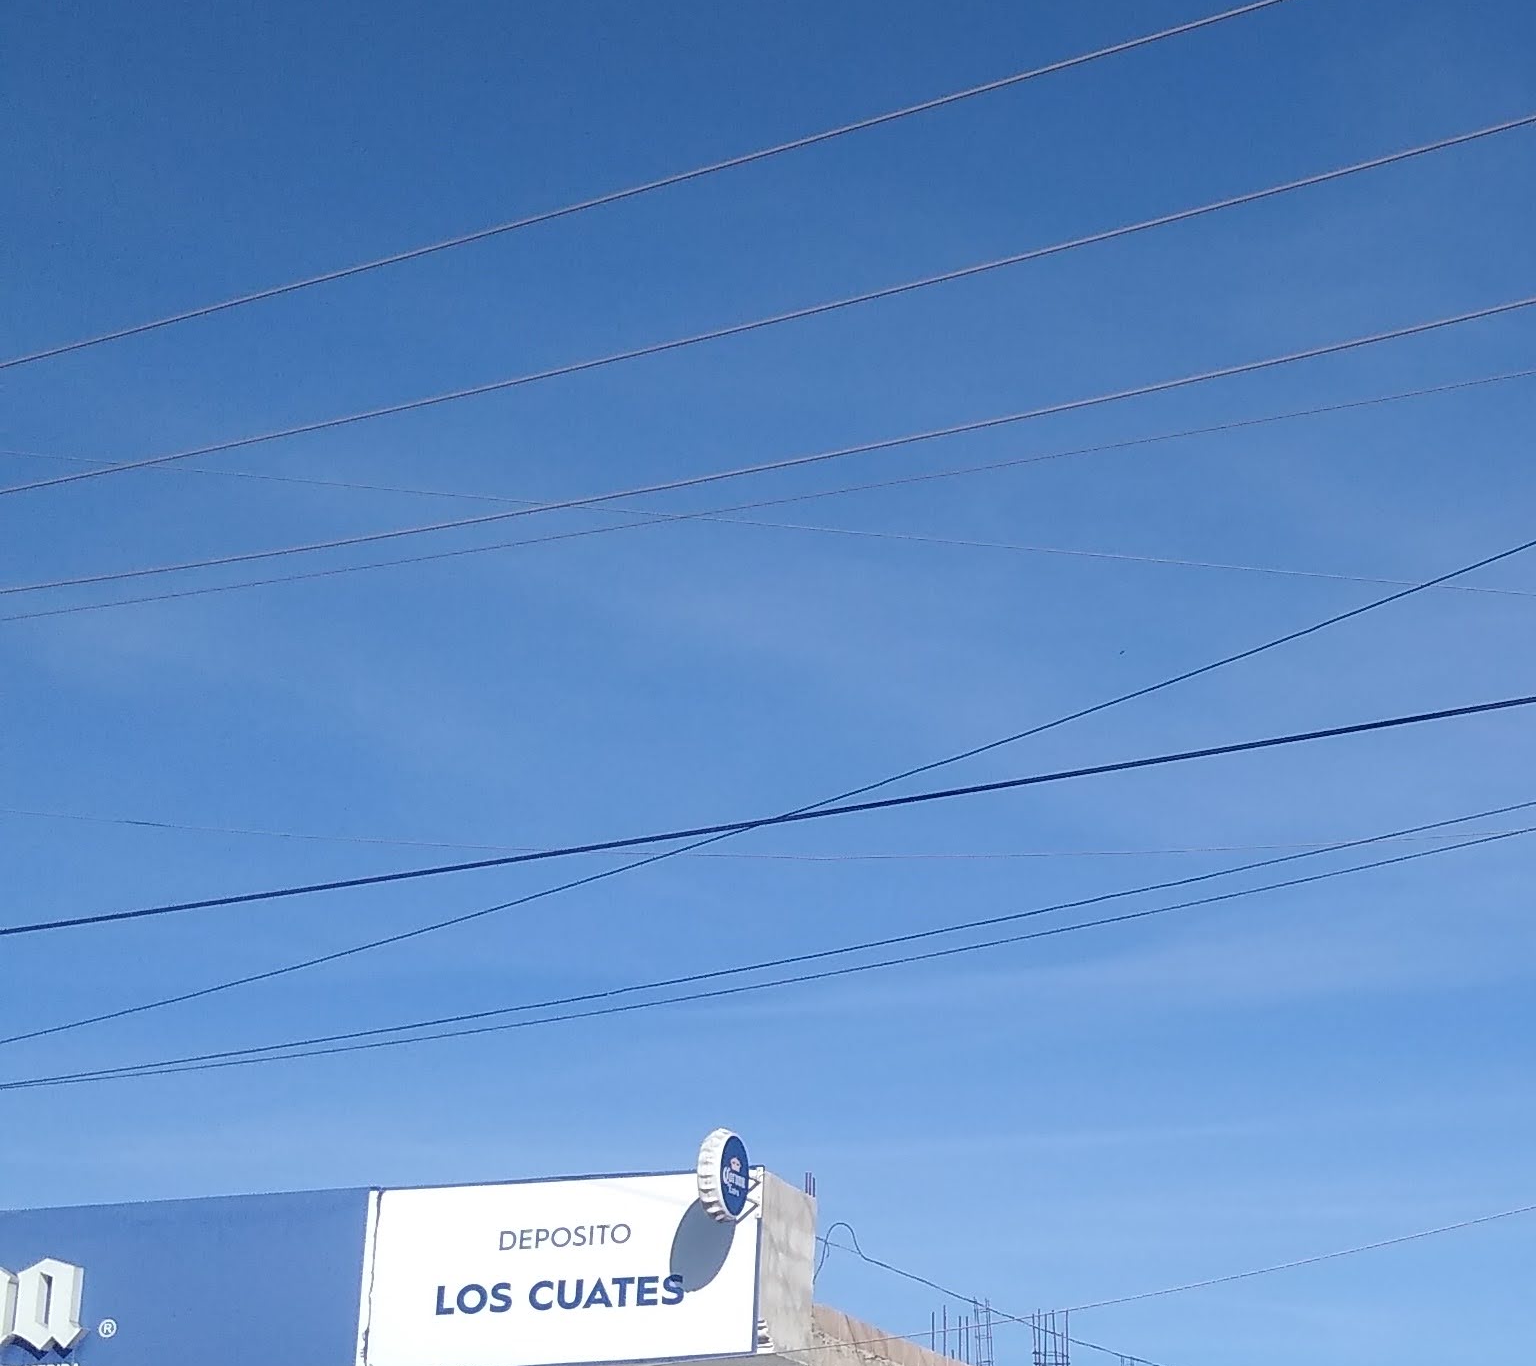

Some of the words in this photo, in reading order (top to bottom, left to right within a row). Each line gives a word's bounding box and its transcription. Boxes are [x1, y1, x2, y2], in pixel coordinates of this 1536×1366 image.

[499, 1223, 632, 1251] DEPOSITO
[436, 1283, 512, 1315] LOS
[529, 1274, 684, 1311] CUATES
